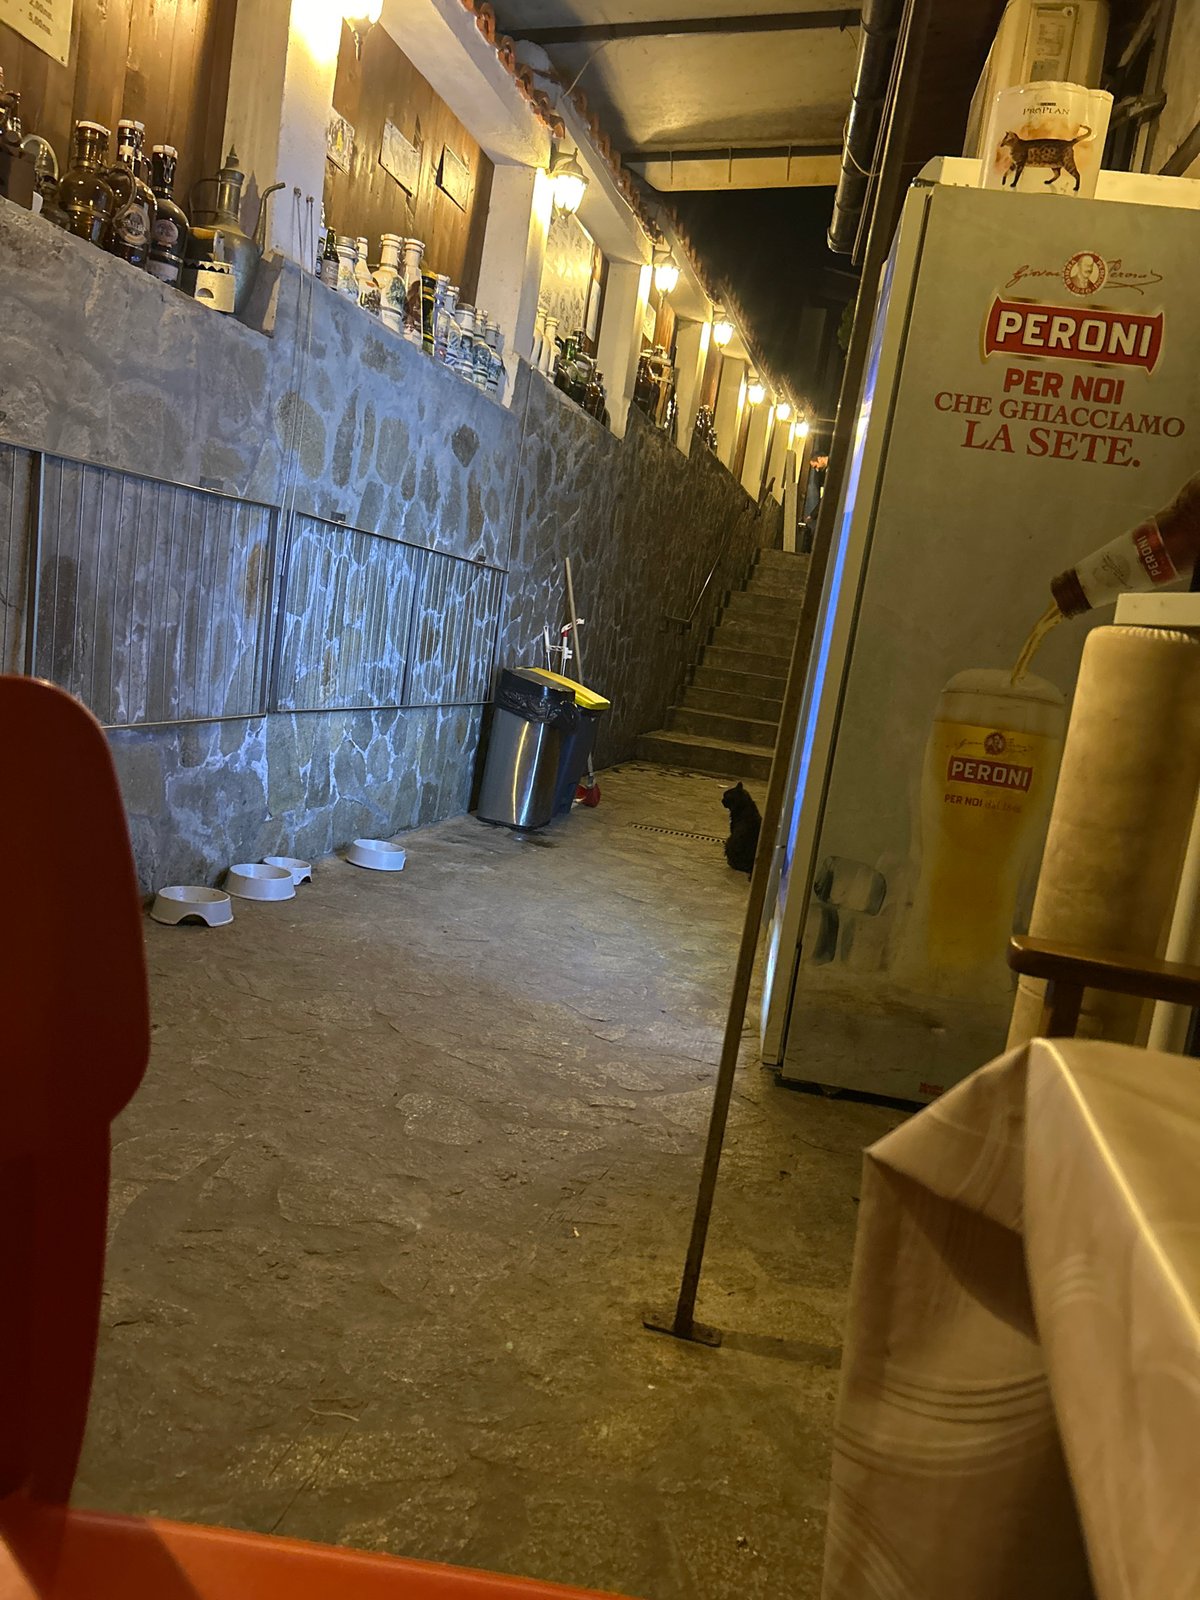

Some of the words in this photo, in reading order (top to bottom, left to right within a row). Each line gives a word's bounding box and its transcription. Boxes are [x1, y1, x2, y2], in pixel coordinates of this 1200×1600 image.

[995, 310, 1153, 358] PERONI
[1003, 367, 1064, 398] PER
[1070, 374, 1125, 405] NOI
[934, 391, 993, 416] CHE
[999, 399, 1186, 438] GHIACCIAMO
[961, 419, 1016, 453] LA
[1026, 426, 1141, 468] SETE.
[1136, 535, 1162, 576] PERONI
[951, 760, 1029, 787] PERONI
[944, 793, 963, 804] PER
[964, 797, 983, 807] NOI
